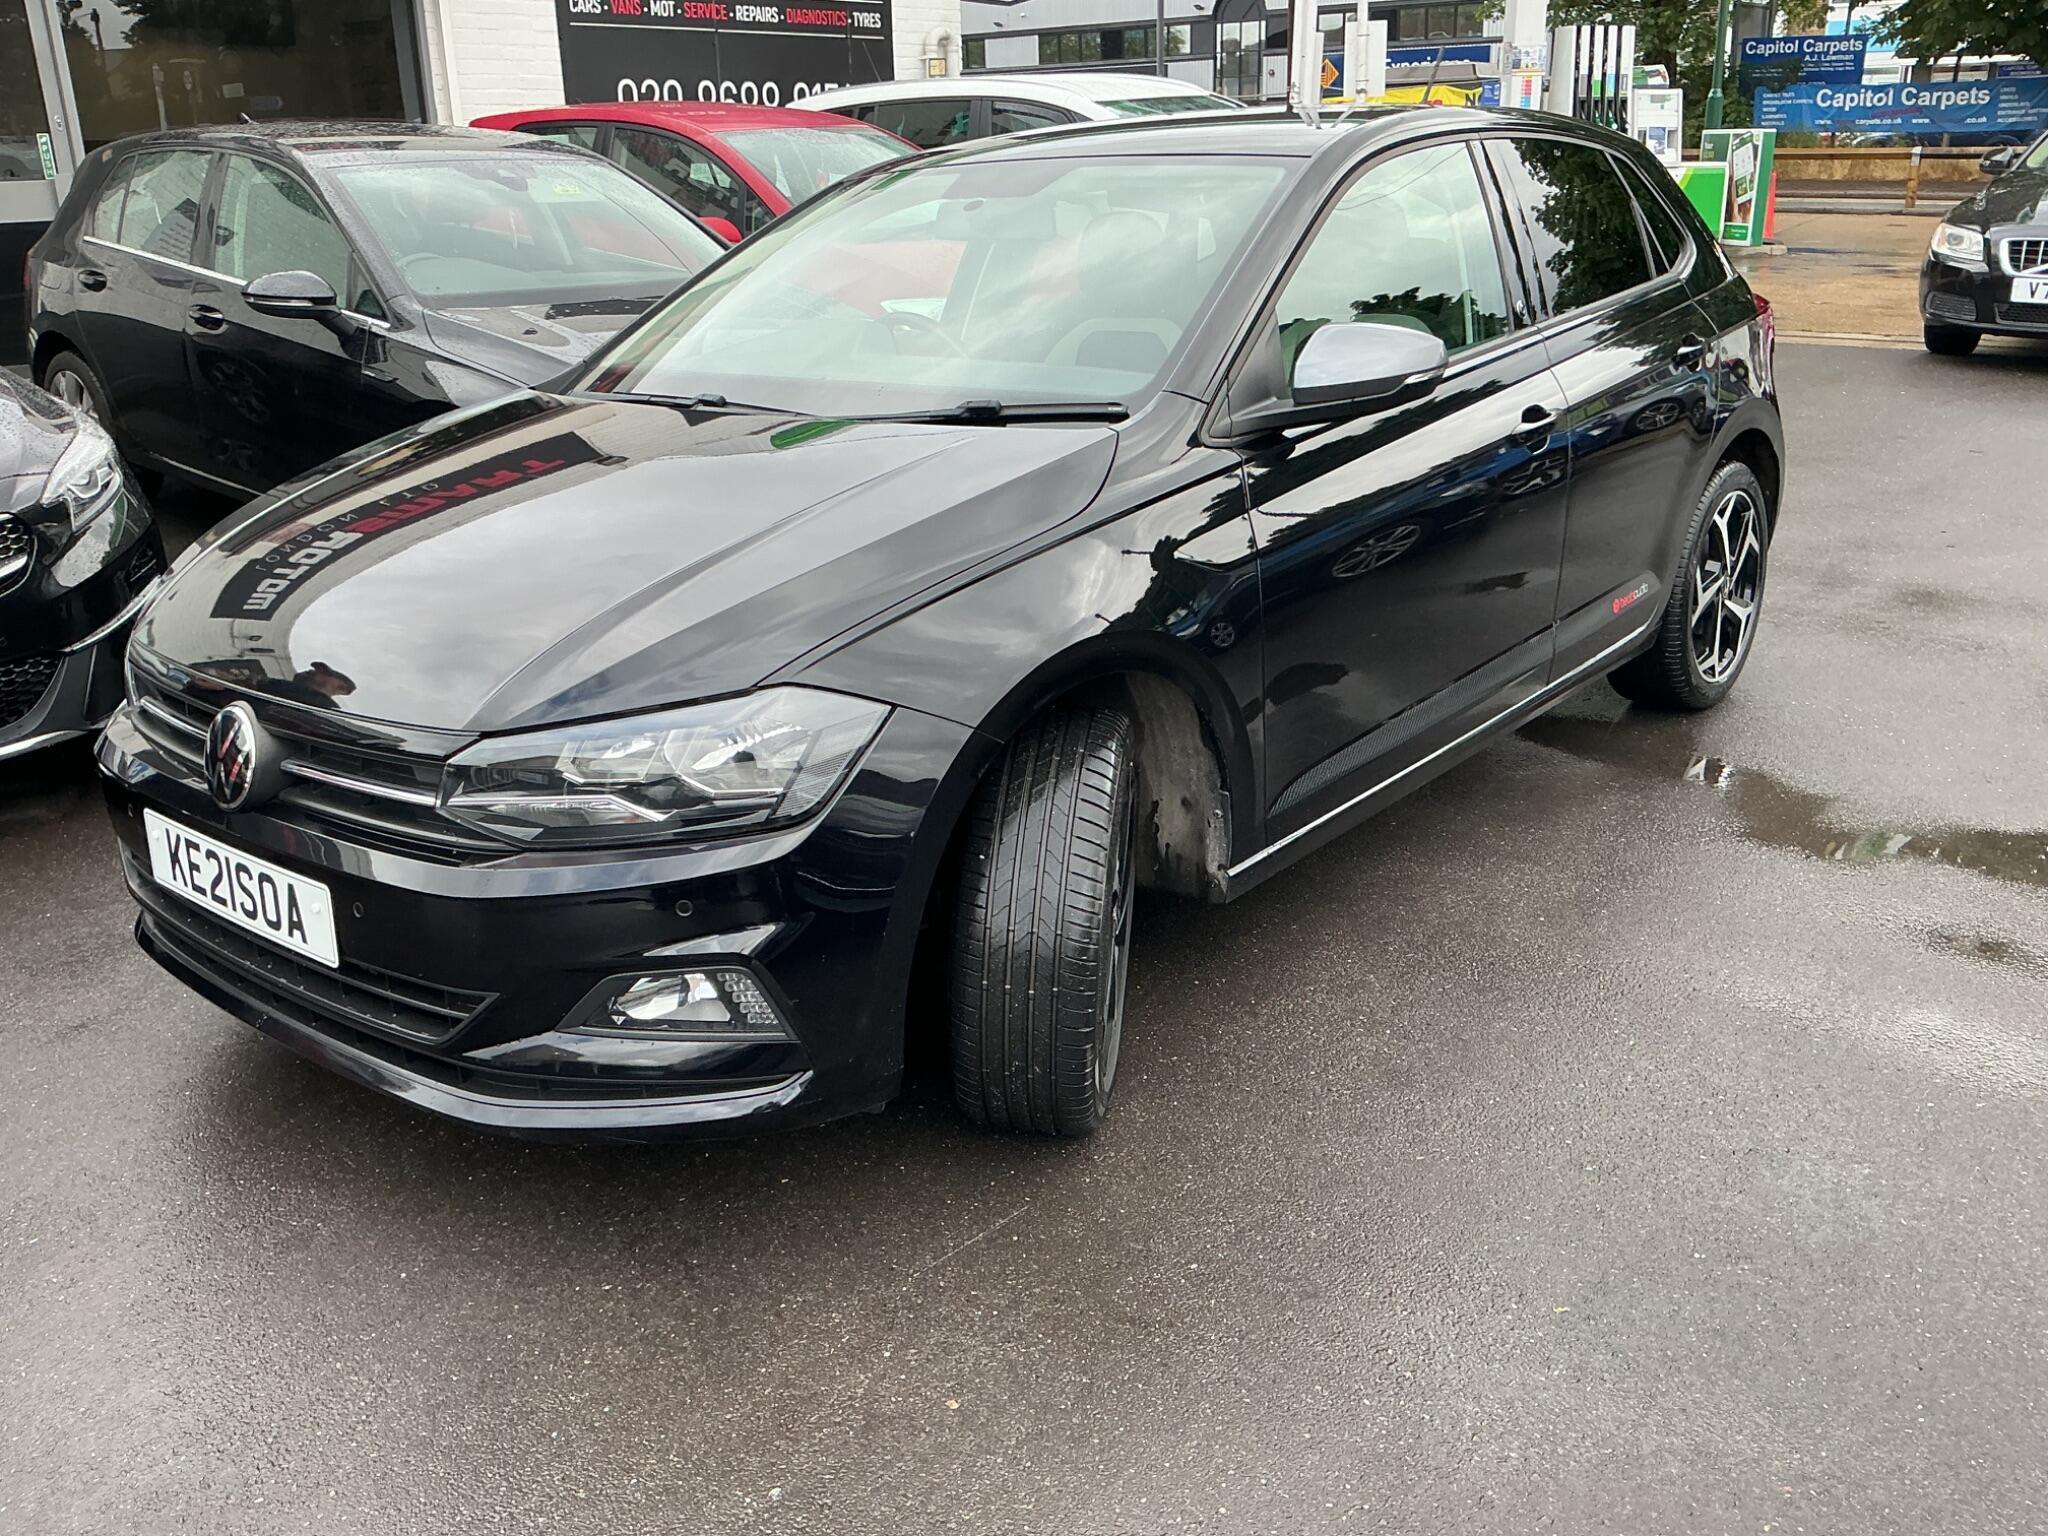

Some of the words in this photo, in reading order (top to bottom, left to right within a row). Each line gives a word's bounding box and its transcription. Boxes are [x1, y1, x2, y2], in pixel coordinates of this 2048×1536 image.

[569, 0, 601, 14] CARS
[611, 0, 642, 16] VANS
[650, 1, 675, 17] MOT
[683, 2, 728, 20] SERVICE
[735, 5, 779, 23] REPAIRS
[786, 8, 847, 26] DIAGNOSTICS
[852, 12, 882, 28] TYRES
[1745, 40, 1799, 57] Capitol
[1803, 38, 1863, 54] Carpets
[1816, 88, 1894, 111] Capitol
[1901, 86, 1991, 110] Carpets
